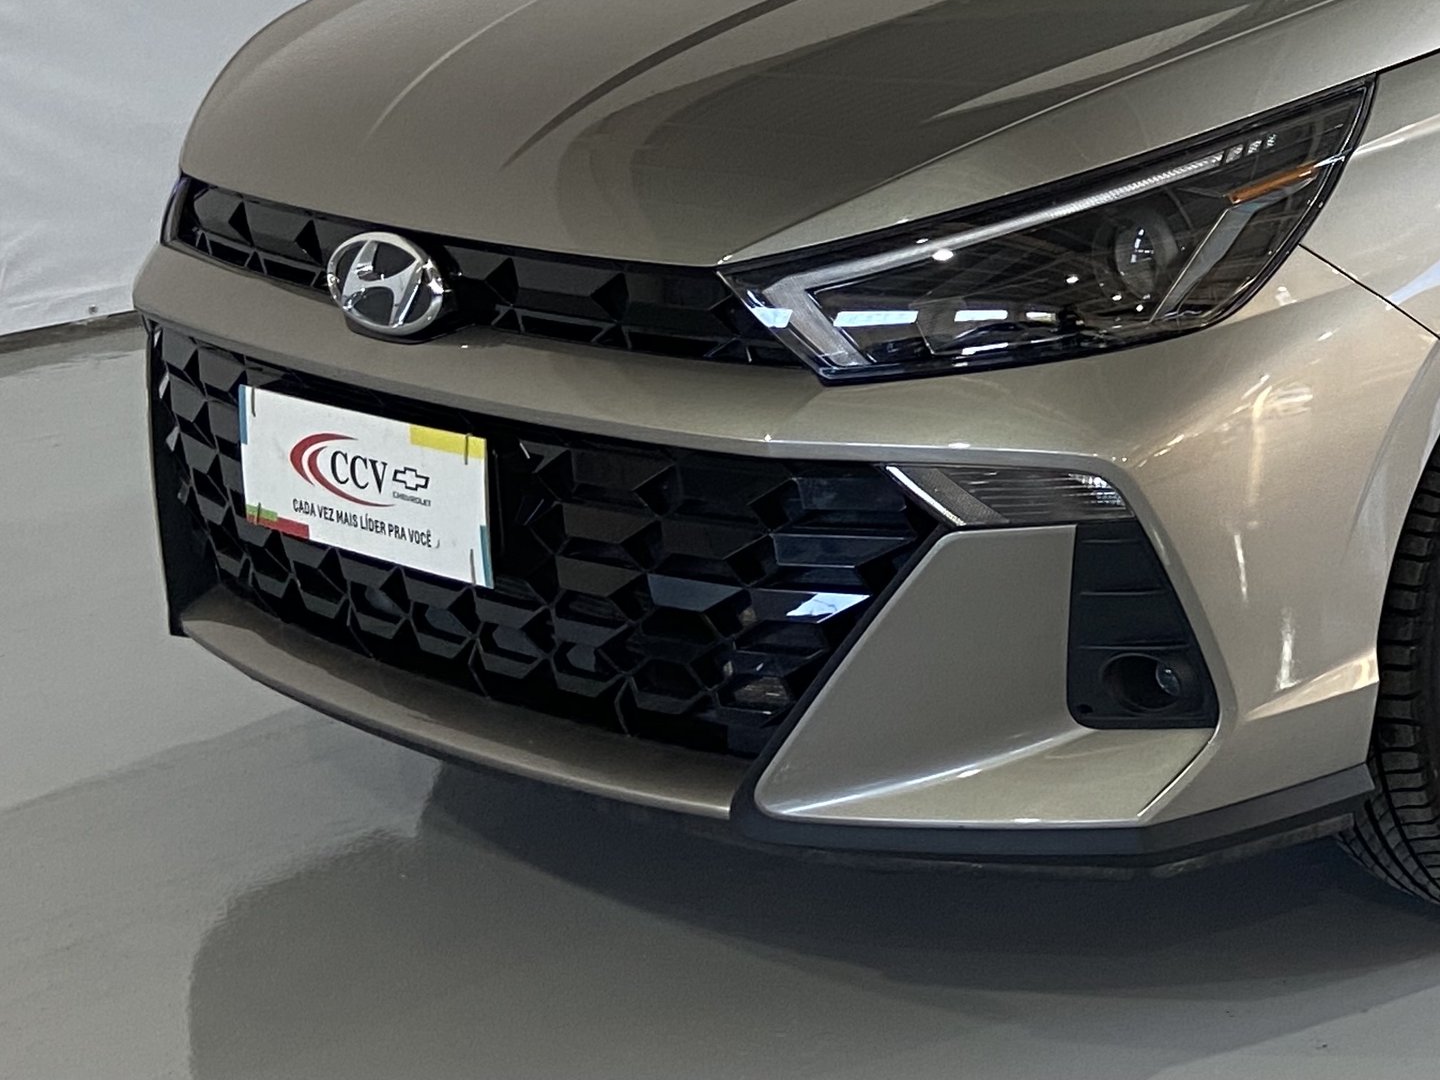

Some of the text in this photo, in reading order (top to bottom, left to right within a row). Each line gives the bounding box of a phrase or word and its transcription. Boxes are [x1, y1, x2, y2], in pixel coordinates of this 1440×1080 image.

[330, 450, 388, 495] CCV
[392, 490, 432, 507] CHEVROLET
[293, 498, 433, 548] CADA VEZ MAIS LÍDER PRA VOCÊ
